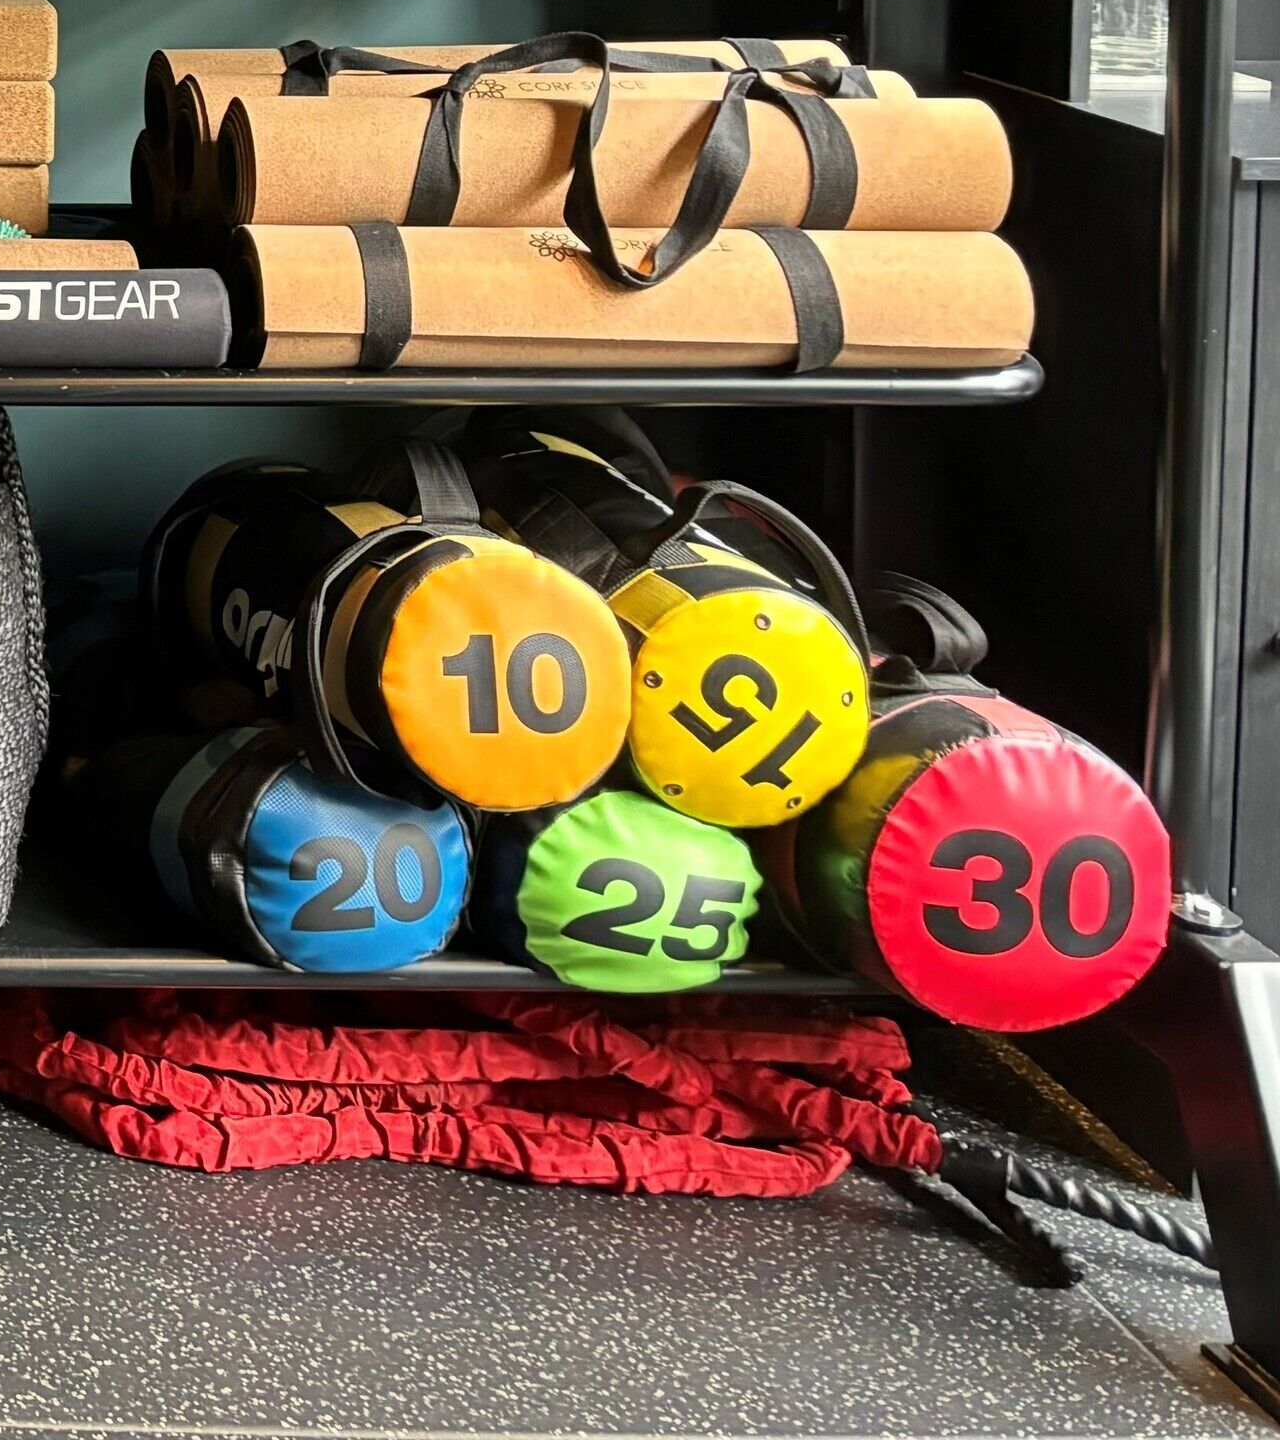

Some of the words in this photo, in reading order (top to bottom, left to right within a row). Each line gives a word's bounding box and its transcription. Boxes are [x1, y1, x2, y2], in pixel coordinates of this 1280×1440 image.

[517, 81, 576, 92] CORK
[441, 631, 588, 735] 10
[669, 654, 824, 790] 15
[288, 822, 442, 932] 20
[561, 857, 748, 962] 25
[922, 827, 1133, 959] 30
